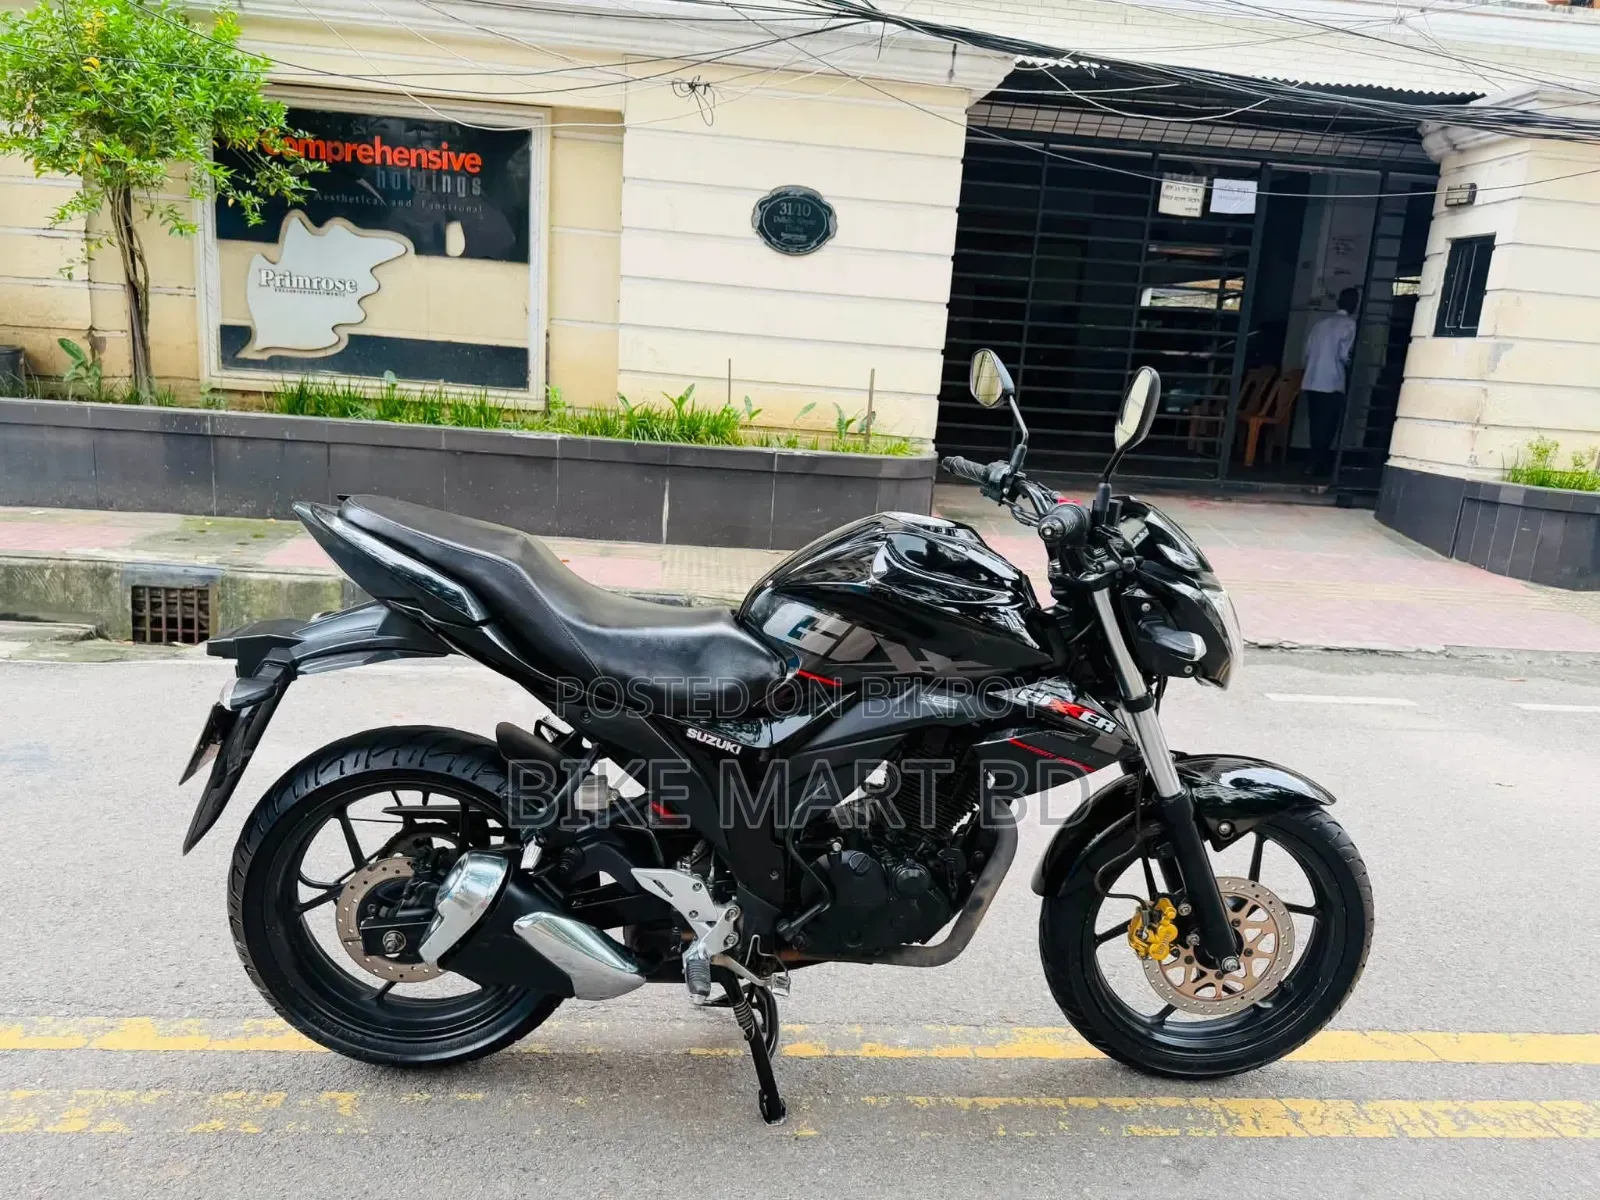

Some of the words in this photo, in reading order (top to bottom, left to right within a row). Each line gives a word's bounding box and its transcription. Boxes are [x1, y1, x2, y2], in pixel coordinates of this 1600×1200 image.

[376, 167, 482, 198] holdings
[259, 268, 358, 294] Primrose
[686, 727, 742, 755] SUZUKI
